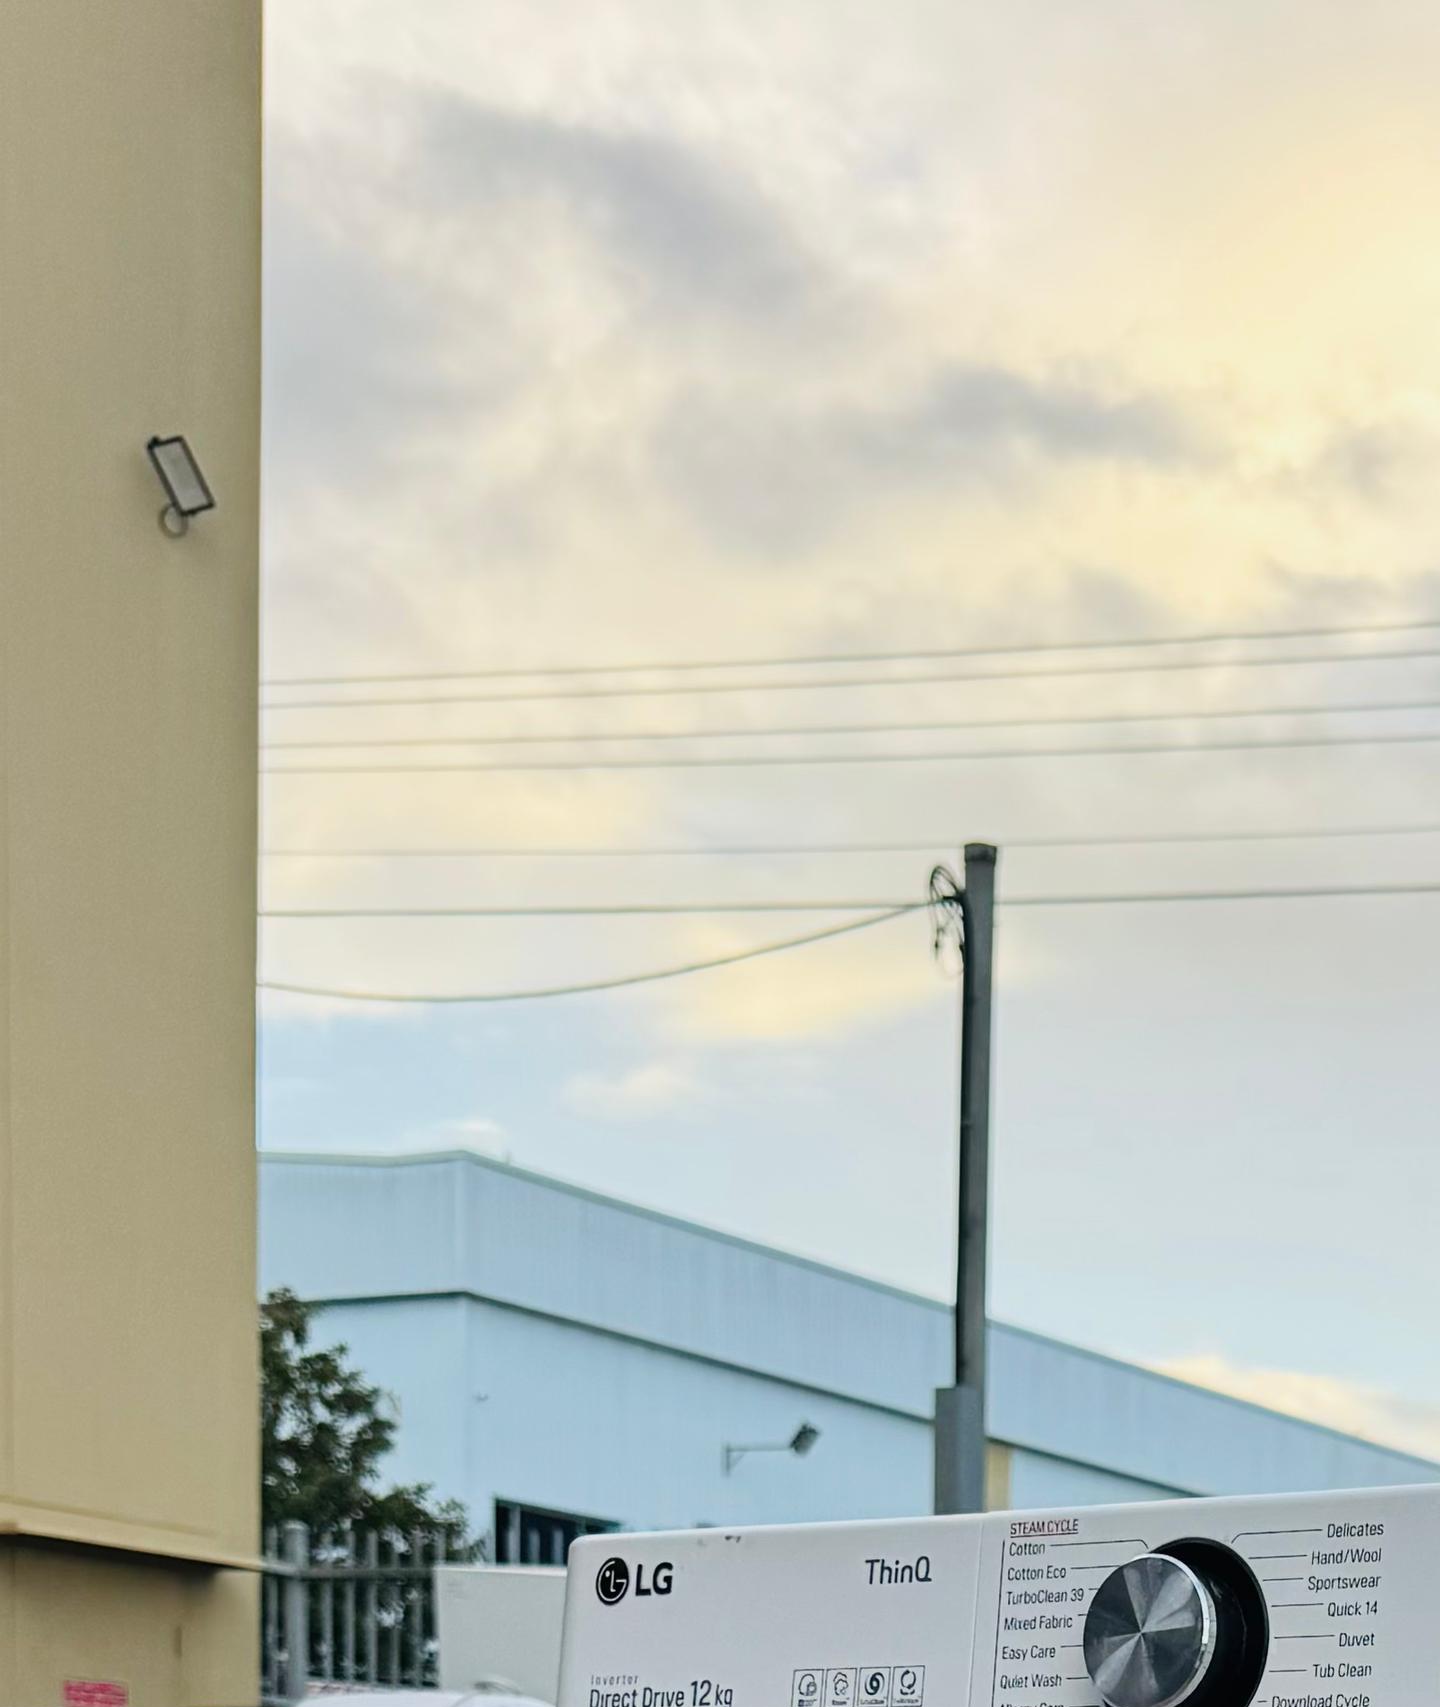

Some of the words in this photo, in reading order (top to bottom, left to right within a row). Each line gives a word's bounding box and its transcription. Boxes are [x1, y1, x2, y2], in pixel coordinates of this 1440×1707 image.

[1010, 1520, 1045, 1536] STEAM
[1047, 1519, 1079, 1535] CYCLE
[1327, 1522, 1384, 1538] Delicates
[1009, 1542, 1045, 1557] Cotton
[1311, 1548, 1382, 1566] Hand/Wool
[864, 1555, 932, 1585] ThinQ
[1007, 1567, 1043, 1581] Cotton
[1047, 1565, 1066, 1580] Eco
[635, 1561, 674, 1597] LG
[1308, 1575, 1382, 1593] Sportswear
[1006, 1590, 1068, 1606] TurboClean
[1070, 1588, 1084, 1602] 39
[1327, 1602, 1361, 1617] Quick
[1365, 1601, 1378, 1616] 14
[1004, 1617, 1036, 1631] Mixed
[1039, 1615, 1073, 1630] Fabric
[1339, 1632, 1375, 1647] Duvet
[1002, 1646, 1027, 1661] Easy
[1030, 1645, 1056, 1659] Care
[1312, 1663, 1335, 1678] Tub
[1338, 1662, 1372, 1677] Clean
[1000, 1675, 1028, 1690] Quiet
[1031, 1674, 1062, 1688] Wash
[642, 1686, 684, 1707] Drive
[690, 1679, 711, 1707] 12
